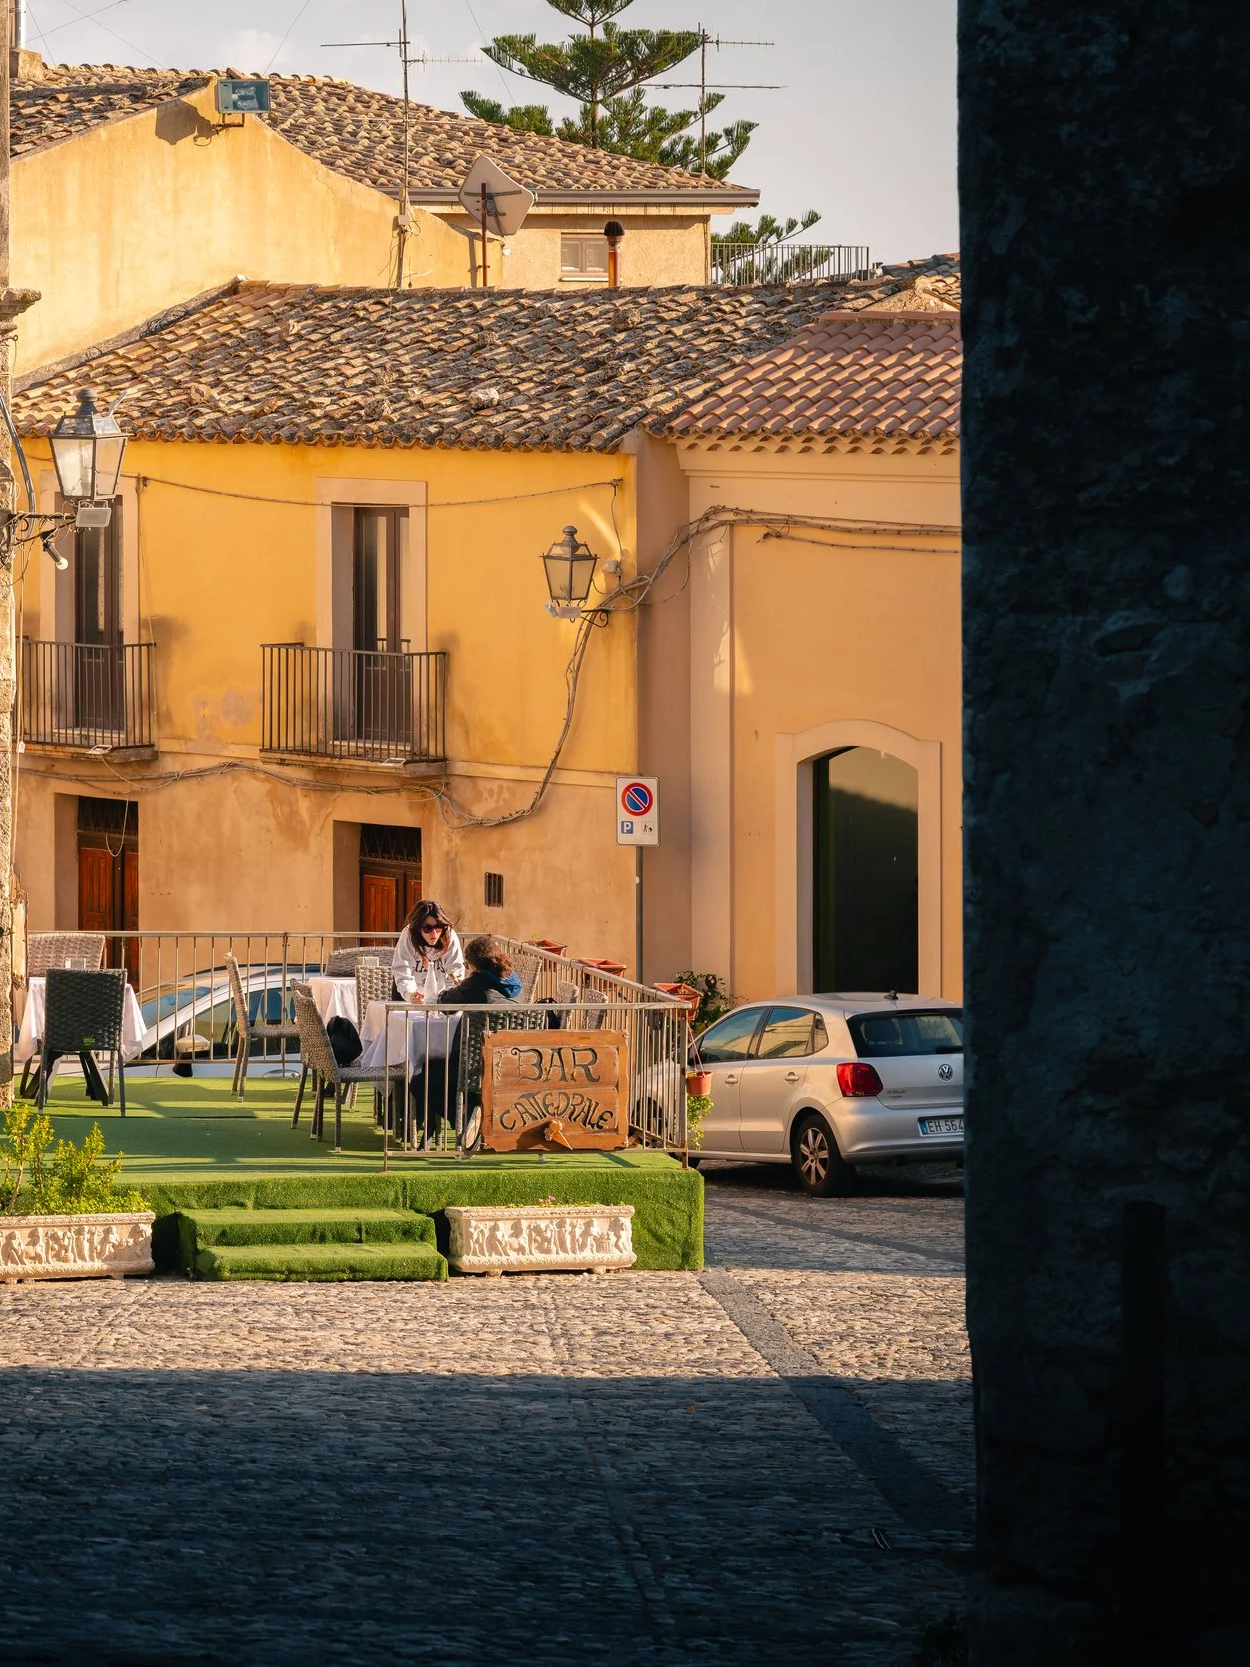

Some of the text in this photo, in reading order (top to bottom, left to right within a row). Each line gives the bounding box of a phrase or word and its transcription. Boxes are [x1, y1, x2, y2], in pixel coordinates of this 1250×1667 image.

[510, 1046, 601, 1083] BAR
[498, 1090, 614, 1130] CATTEDRALE
[927, 1119, 942, 1133] EH
